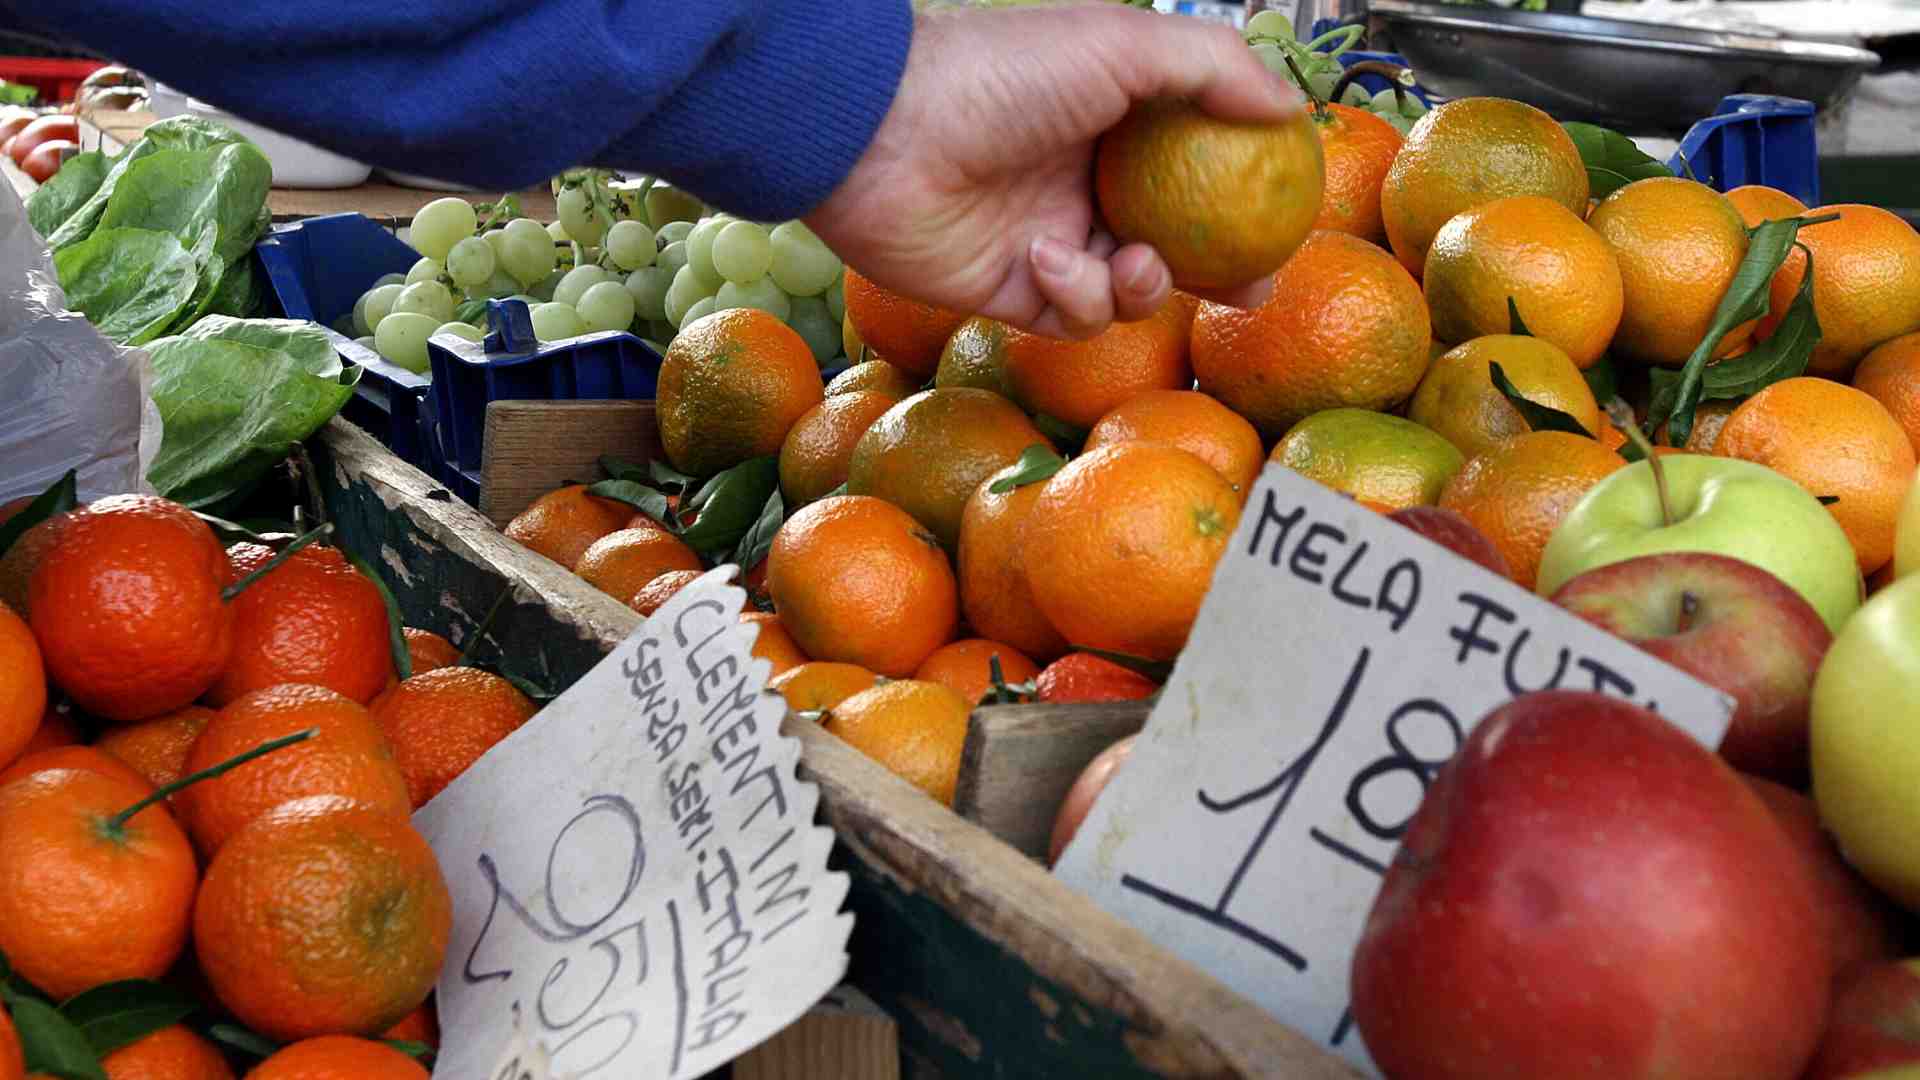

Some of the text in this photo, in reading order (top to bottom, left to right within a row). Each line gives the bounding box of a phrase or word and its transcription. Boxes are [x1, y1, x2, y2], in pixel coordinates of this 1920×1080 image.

[1248, 488, 1423, 633] MELA
[621, 637, 688, 763] SENZA
[688, 847, 752, 1052] ITALIA
[675, 599, 812, 945] CLEMENTINI
